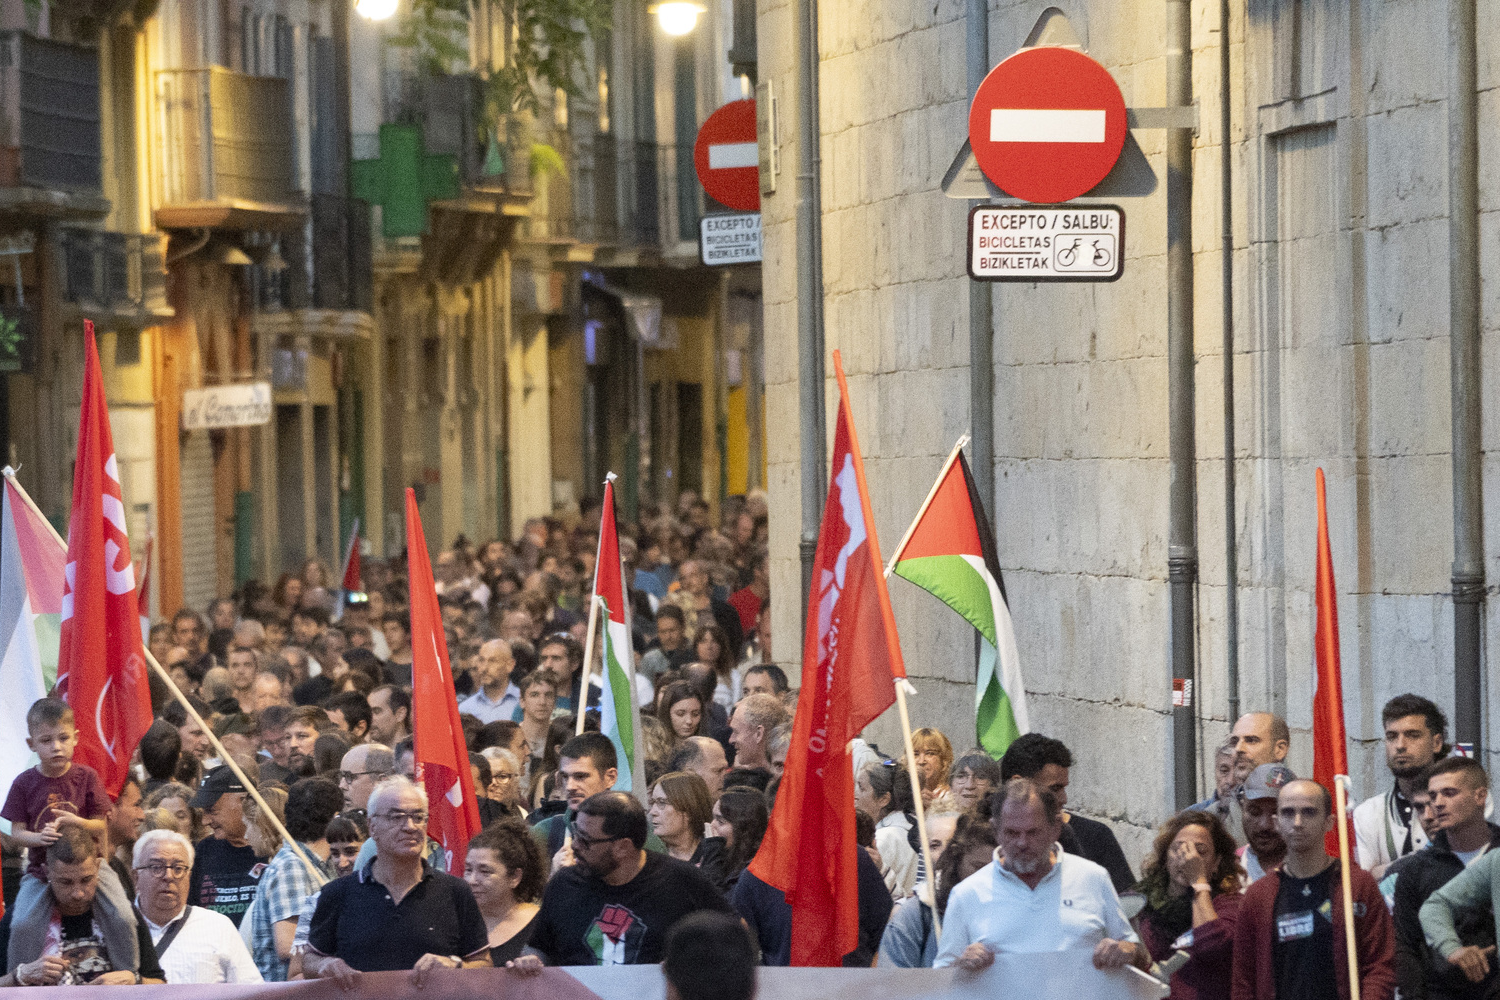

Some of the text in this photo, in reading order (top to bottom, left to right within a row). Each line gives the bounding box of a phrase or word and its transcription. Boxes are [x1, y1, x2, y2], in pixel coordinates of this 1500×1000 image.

[706, 218, 753, 232] EXCEPTO
[981, 213, 1113, 230] EXCEPTO / SALBU:
[706, 232, 758, 246] BICICLETAS
[979, 236, 1050, 249] BICICLETAS
[708, 247, 757, 260] BIZIKLETAK
[980, 256, 1049, 270] BIZIKLETAK
